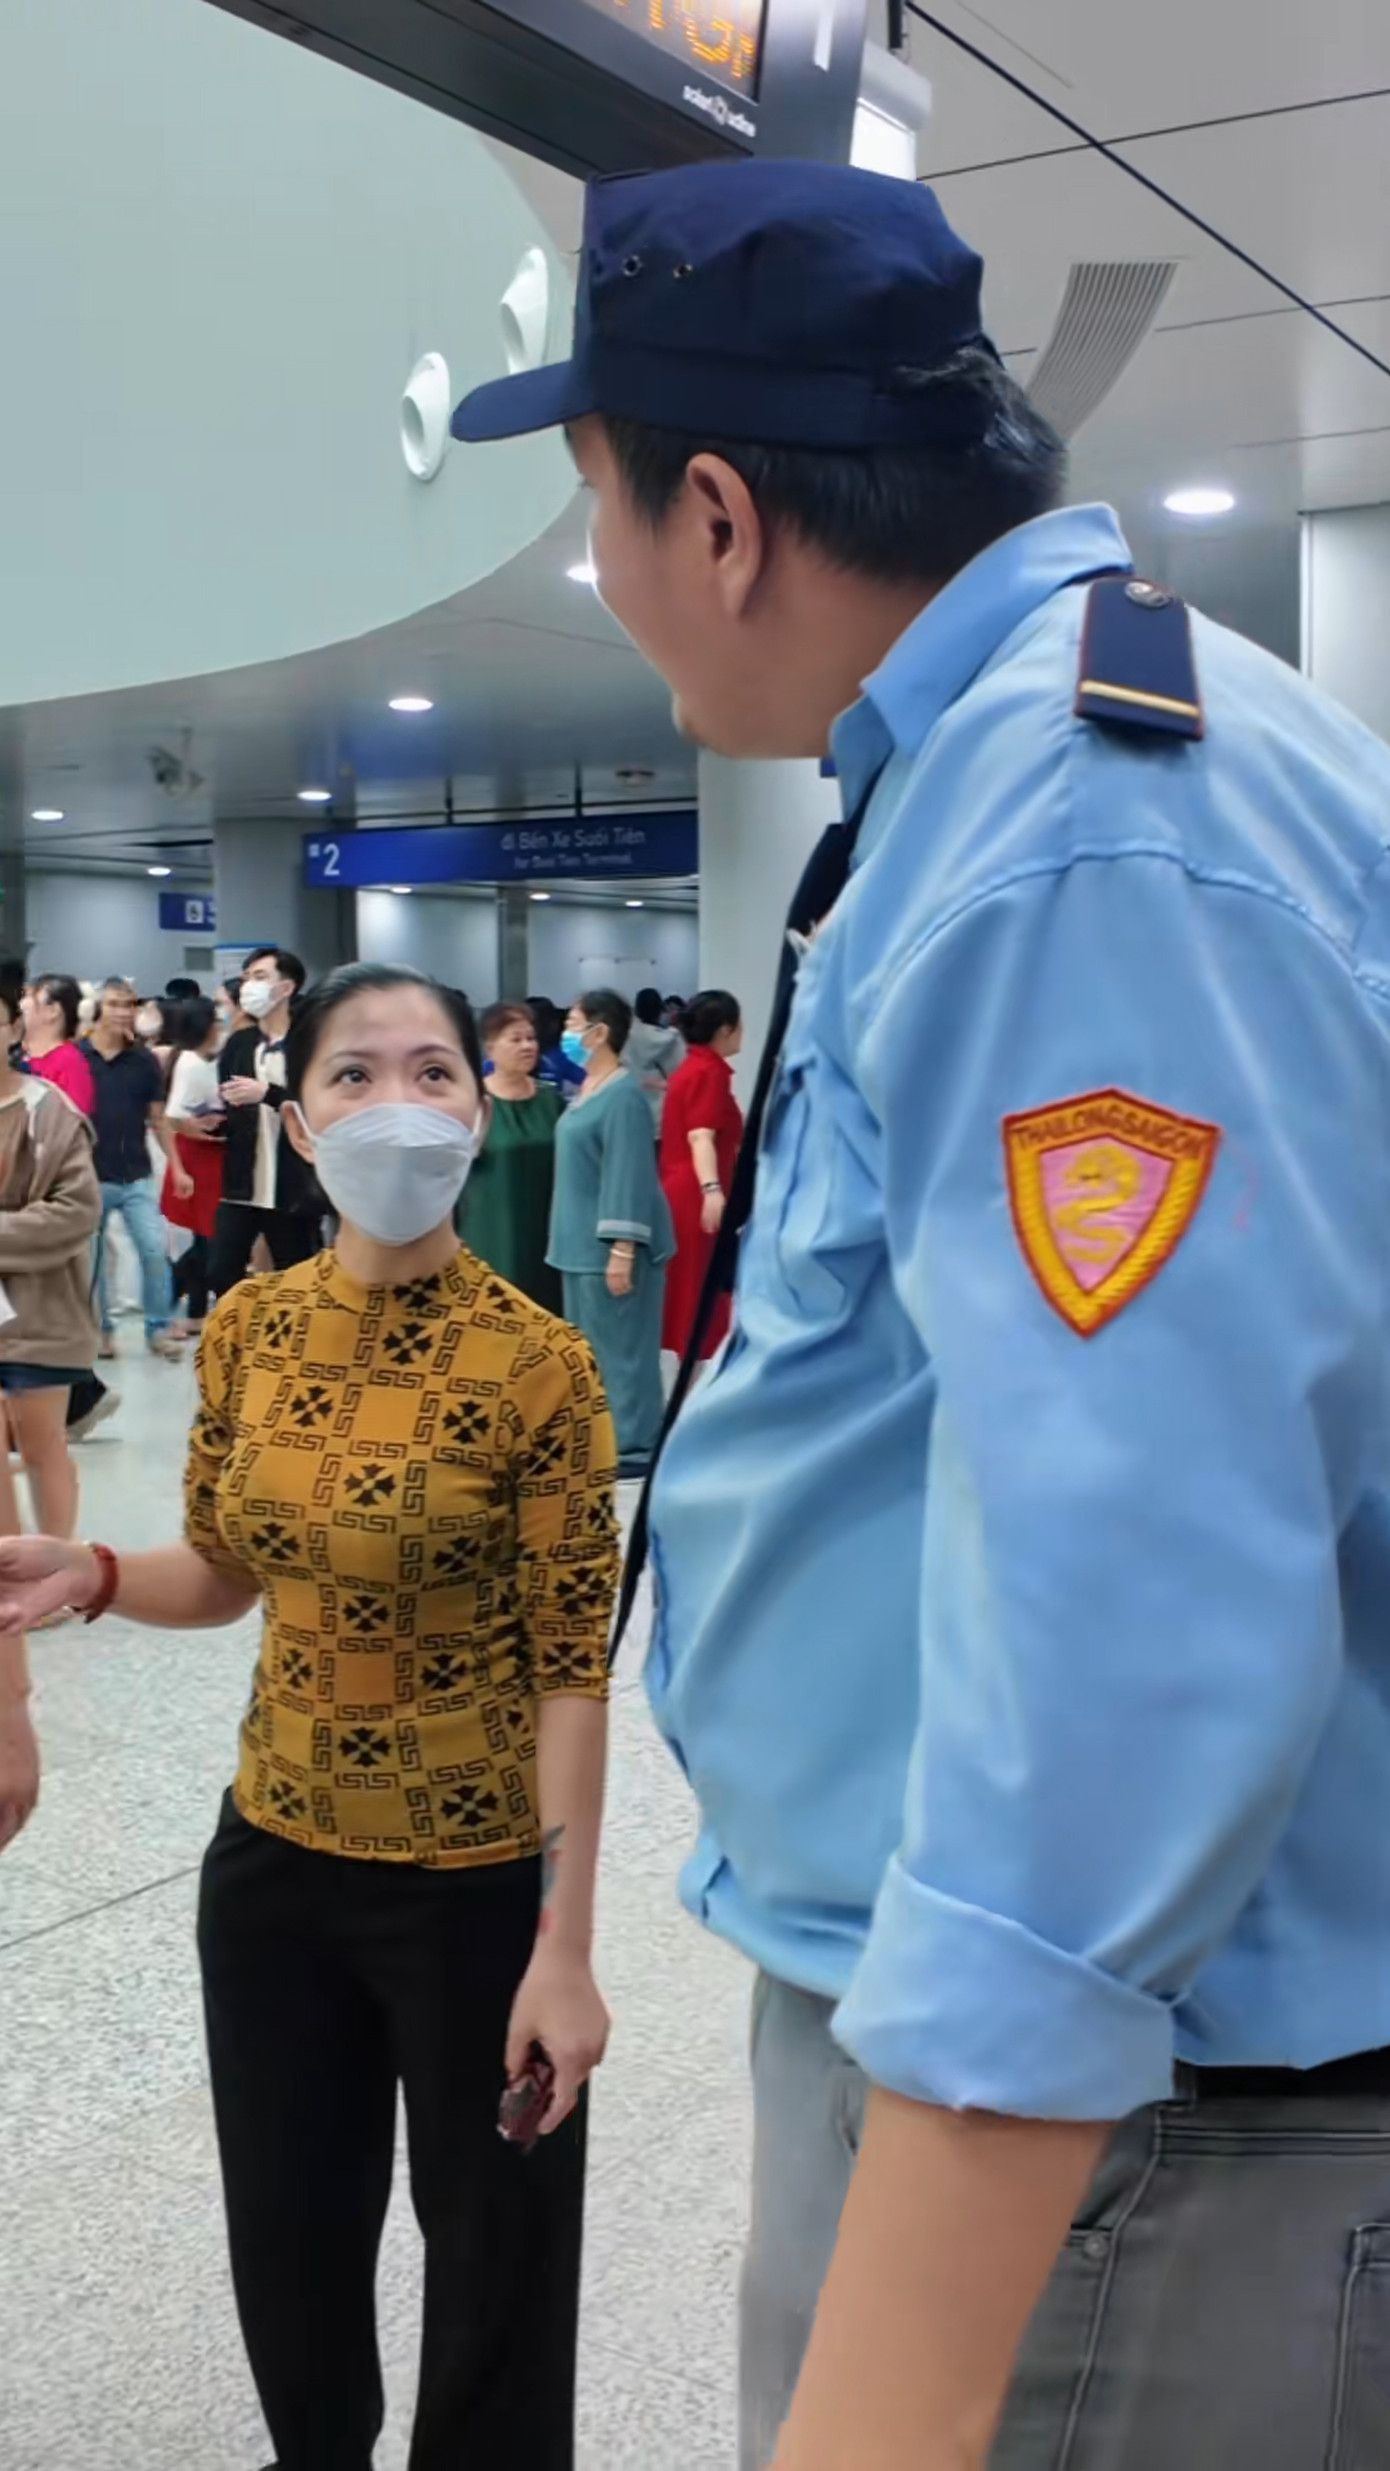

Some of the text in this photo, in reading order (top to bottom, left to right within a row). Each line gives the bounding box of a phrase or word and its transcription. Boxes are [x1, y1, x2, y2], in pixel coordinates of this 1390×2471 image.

[551, 830, 572, 848] Xe
[613, 826, 646, 845] Tiên
[323, 843, 341, 876] 2
